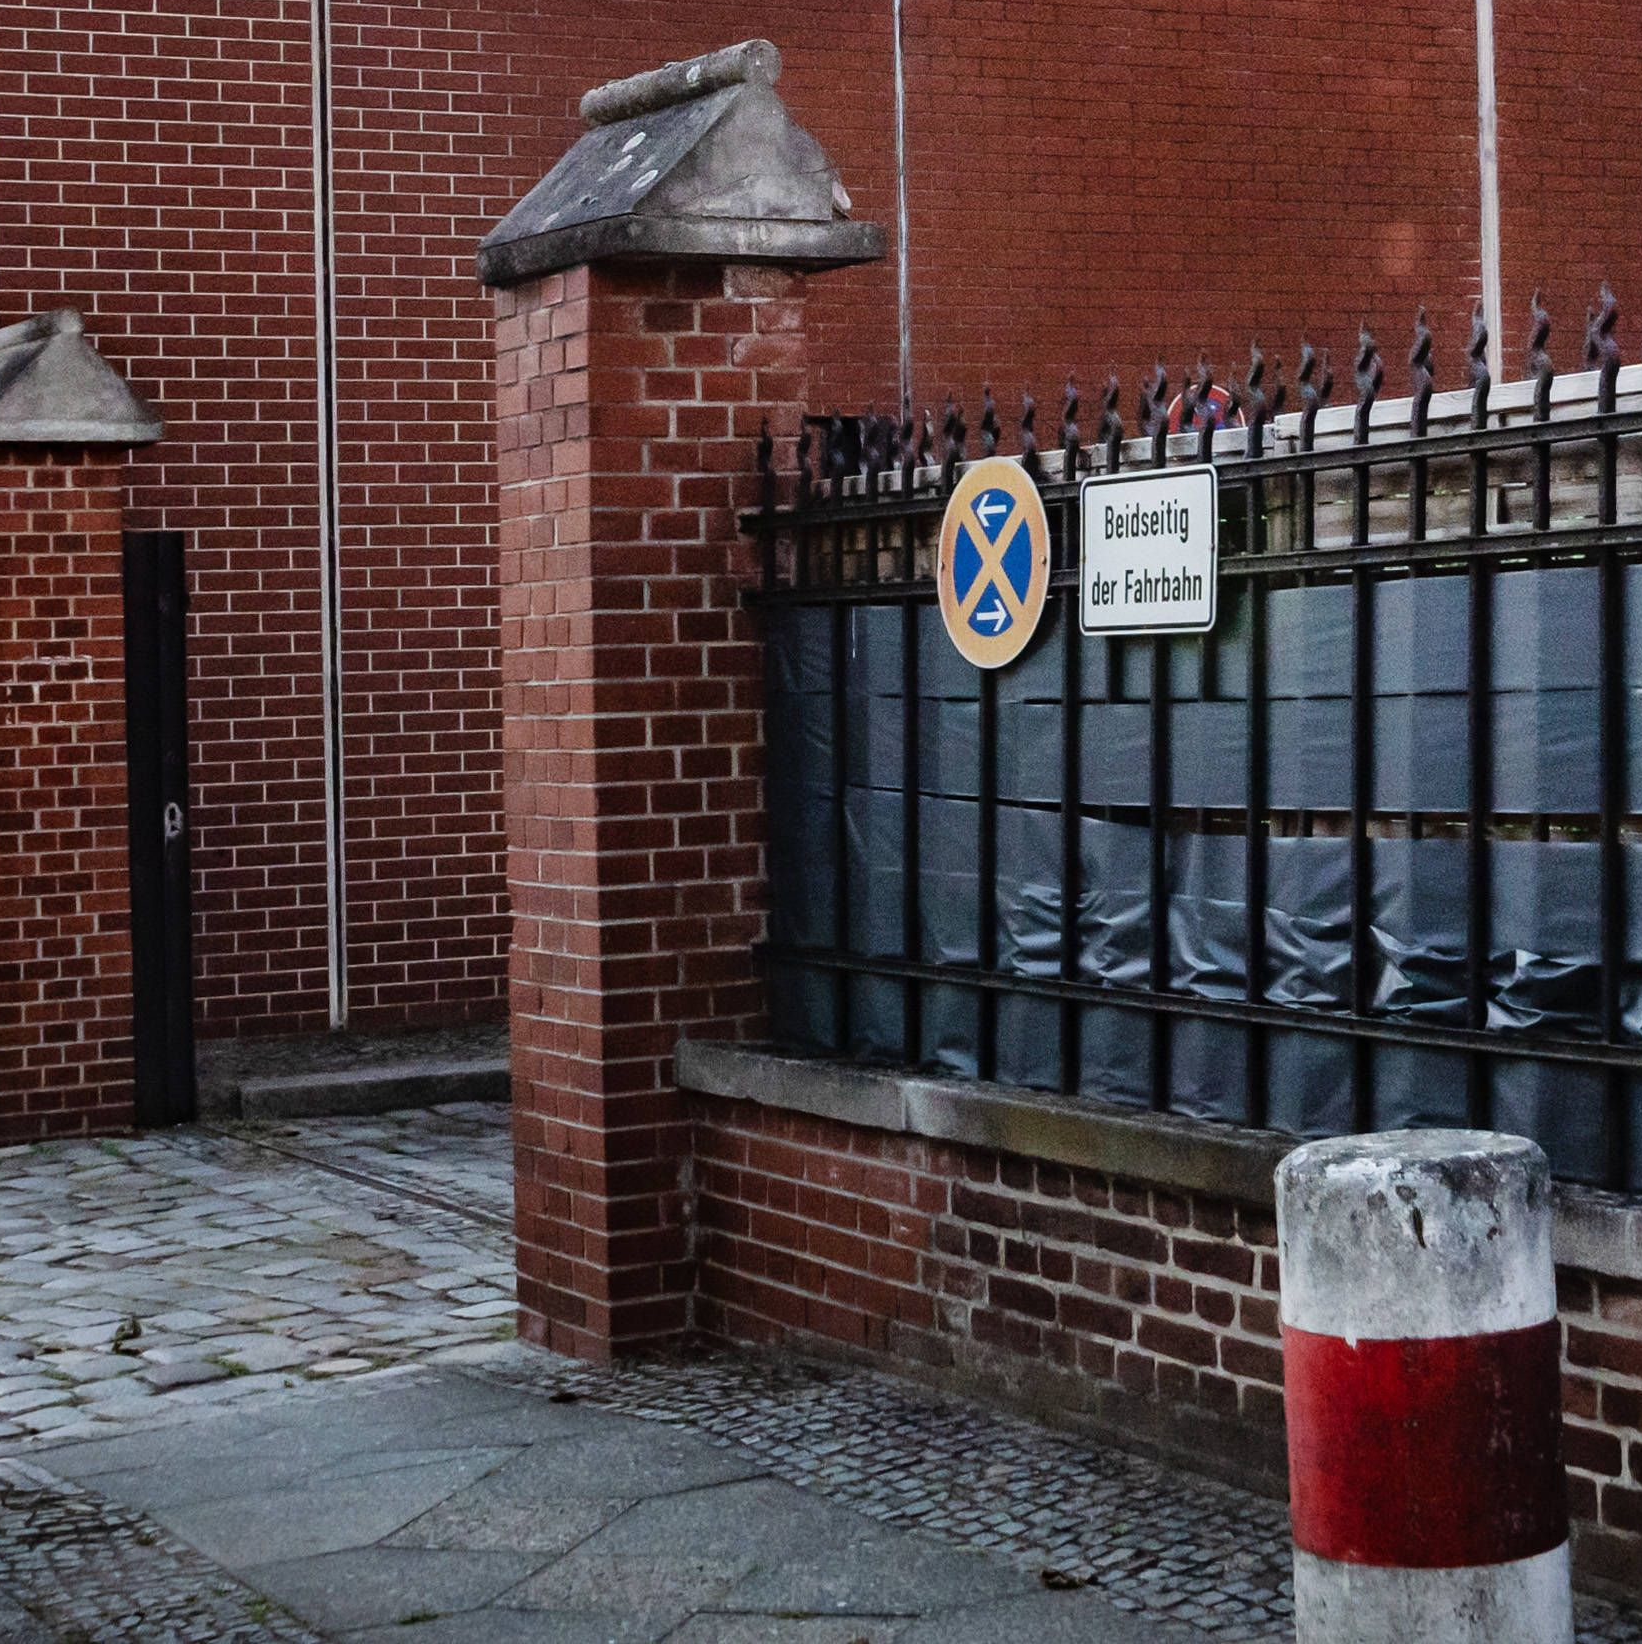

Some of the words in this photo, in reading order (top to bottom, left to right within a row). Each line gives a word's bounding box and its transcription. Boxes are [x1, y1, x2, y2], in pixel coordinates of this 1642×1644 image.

[1104, 499, 1189, 543] Beidseitig
[1092, 571, 1117, 606] der
[1125, 566, 1202, 604] Fahrbahn
